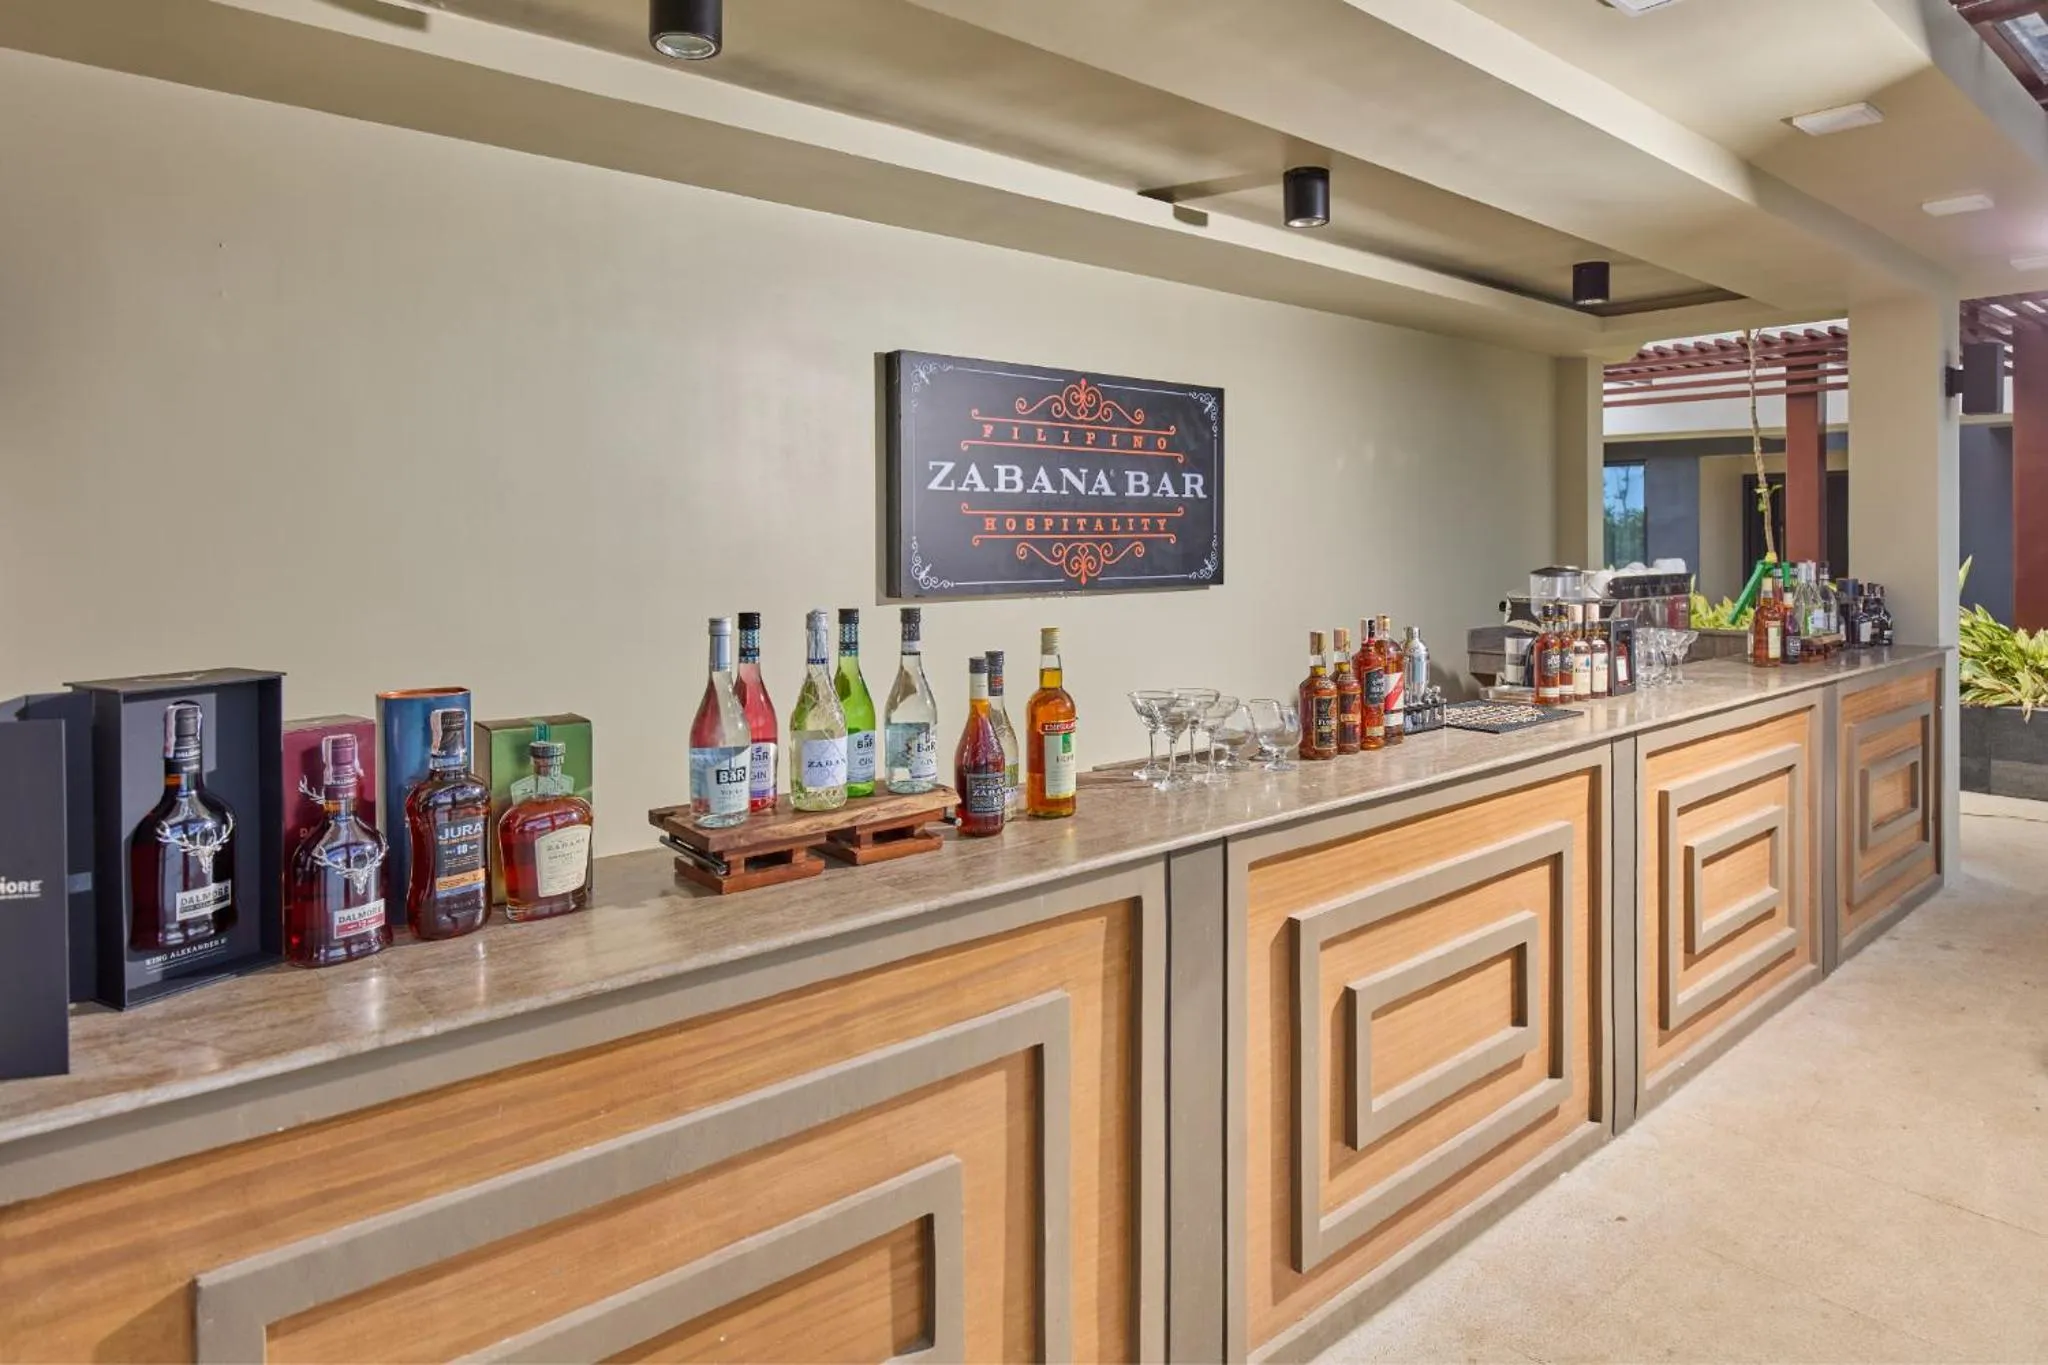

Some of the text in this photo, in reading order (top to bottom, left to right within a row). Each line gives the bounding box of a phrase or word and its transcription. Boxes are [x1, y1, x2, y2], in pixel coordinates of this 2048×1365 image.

[983, 424, 1167, 450] FILIPINO
[927, 461, 1208, 498] ZABANA BAR
[984, 517, 1169, 531] HOSPITALITY
[438, 822, 483, 840] JURA
[180, 885, 230, 906] DALMORE
[338, 905, 381, 924] DALMORE
